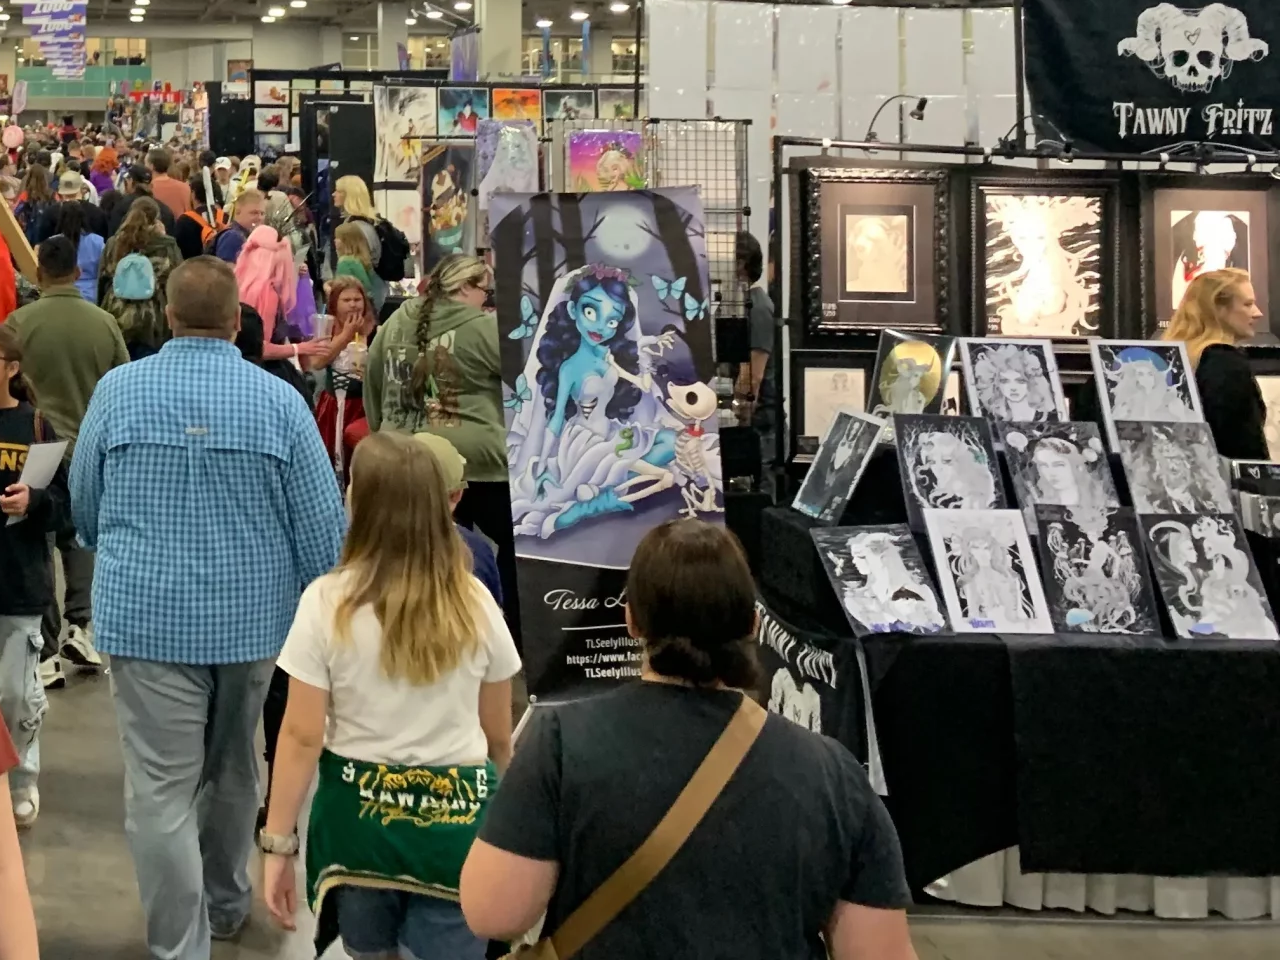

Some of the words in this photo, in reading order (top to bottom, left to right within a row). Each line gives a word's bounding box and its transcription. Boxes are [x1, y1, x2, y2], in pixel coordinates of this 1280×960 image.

[1112, 101, 1192, 139] TAWNY
[544, 588, 600, 610] Tessa
[566, 651, 644, 667] https://www.fac
[584, 666, 642, 680] TLSeelyIllus
